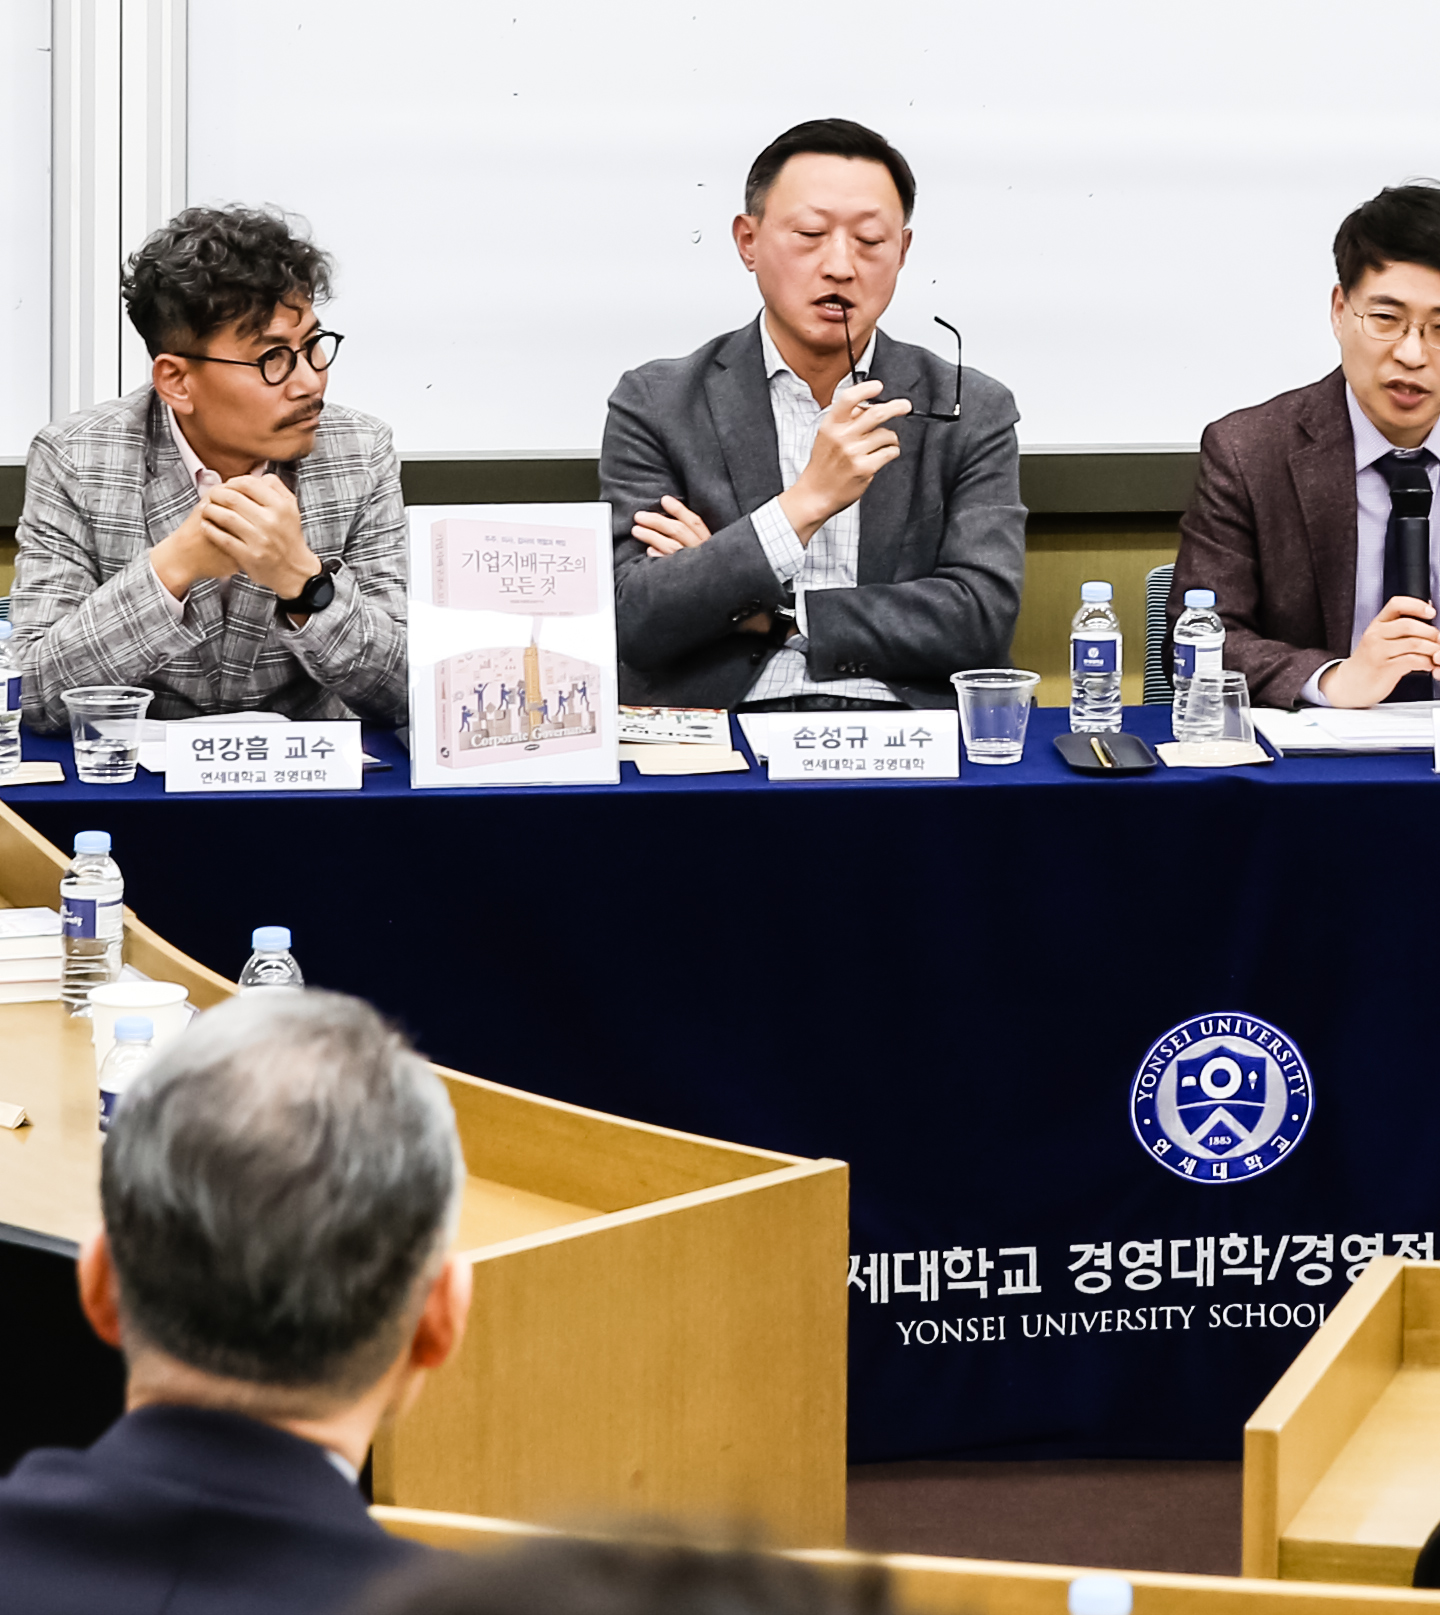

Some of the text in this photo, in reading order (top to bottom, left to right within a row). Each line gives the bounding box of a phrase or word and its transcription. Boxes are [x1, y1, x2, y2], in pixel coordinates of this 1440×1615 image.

[462, 549, 586, 574] 기업지배구조의
[499, 575, 556, 596] 모든 것
[191, 736, 335, 762] 연강흠 교수
[793, 726, 933, 749] 손성규 교수
[1137, 1018, 1305, 1102] YONSEI UNIVERSITY
[1153, 1135, 1291, 1179] 연세대학교
[847, 1246, 1041, 1304] 세대학교
[896, 1303, 1325, 1345] YONSEI UNIVERSITY SCHOOL
